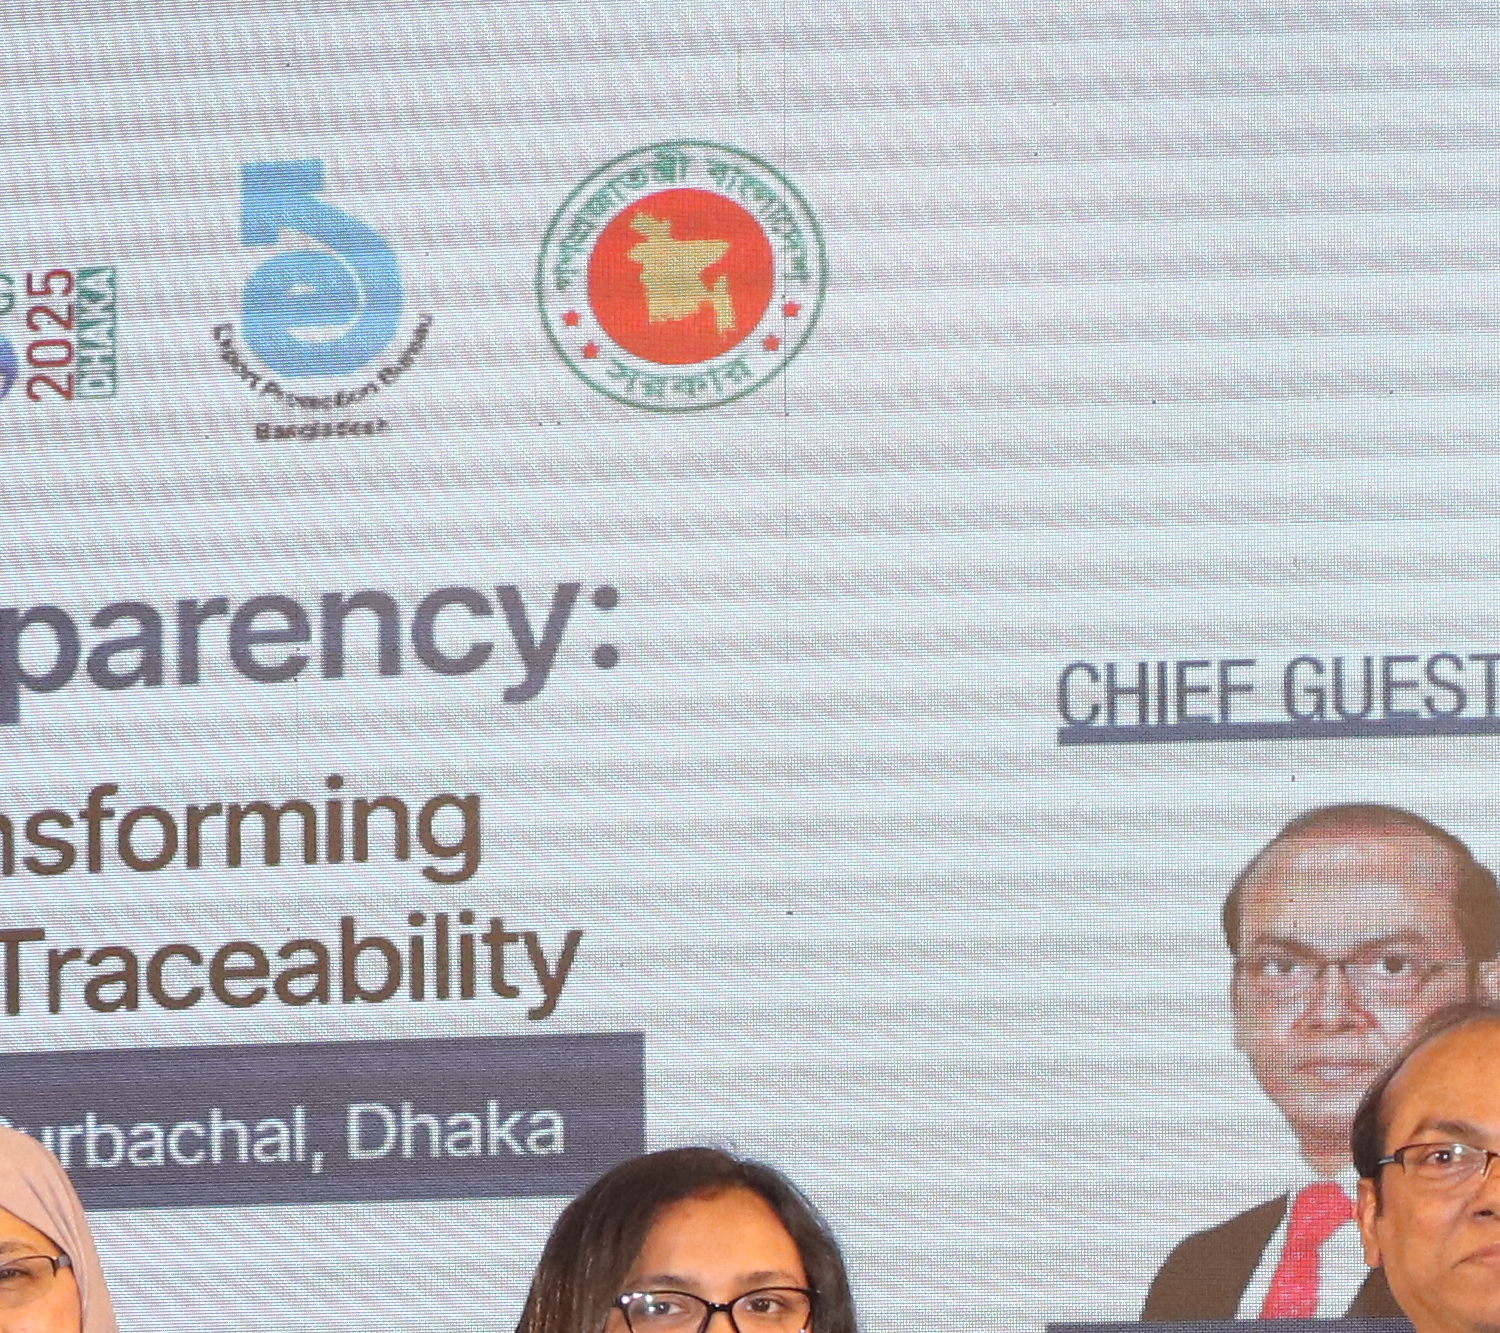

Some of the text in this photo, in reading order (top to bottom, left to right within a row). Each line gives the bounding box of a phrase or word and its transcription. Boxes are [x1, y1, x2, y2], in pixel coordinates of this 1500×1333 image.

[26, 268, 75, 401] 2025
[254, 417, 393, 441] Bangladesh
[1057, 657, 1257, 729] CHIEF
[346, 1099, 567, 1161] Dhaka
